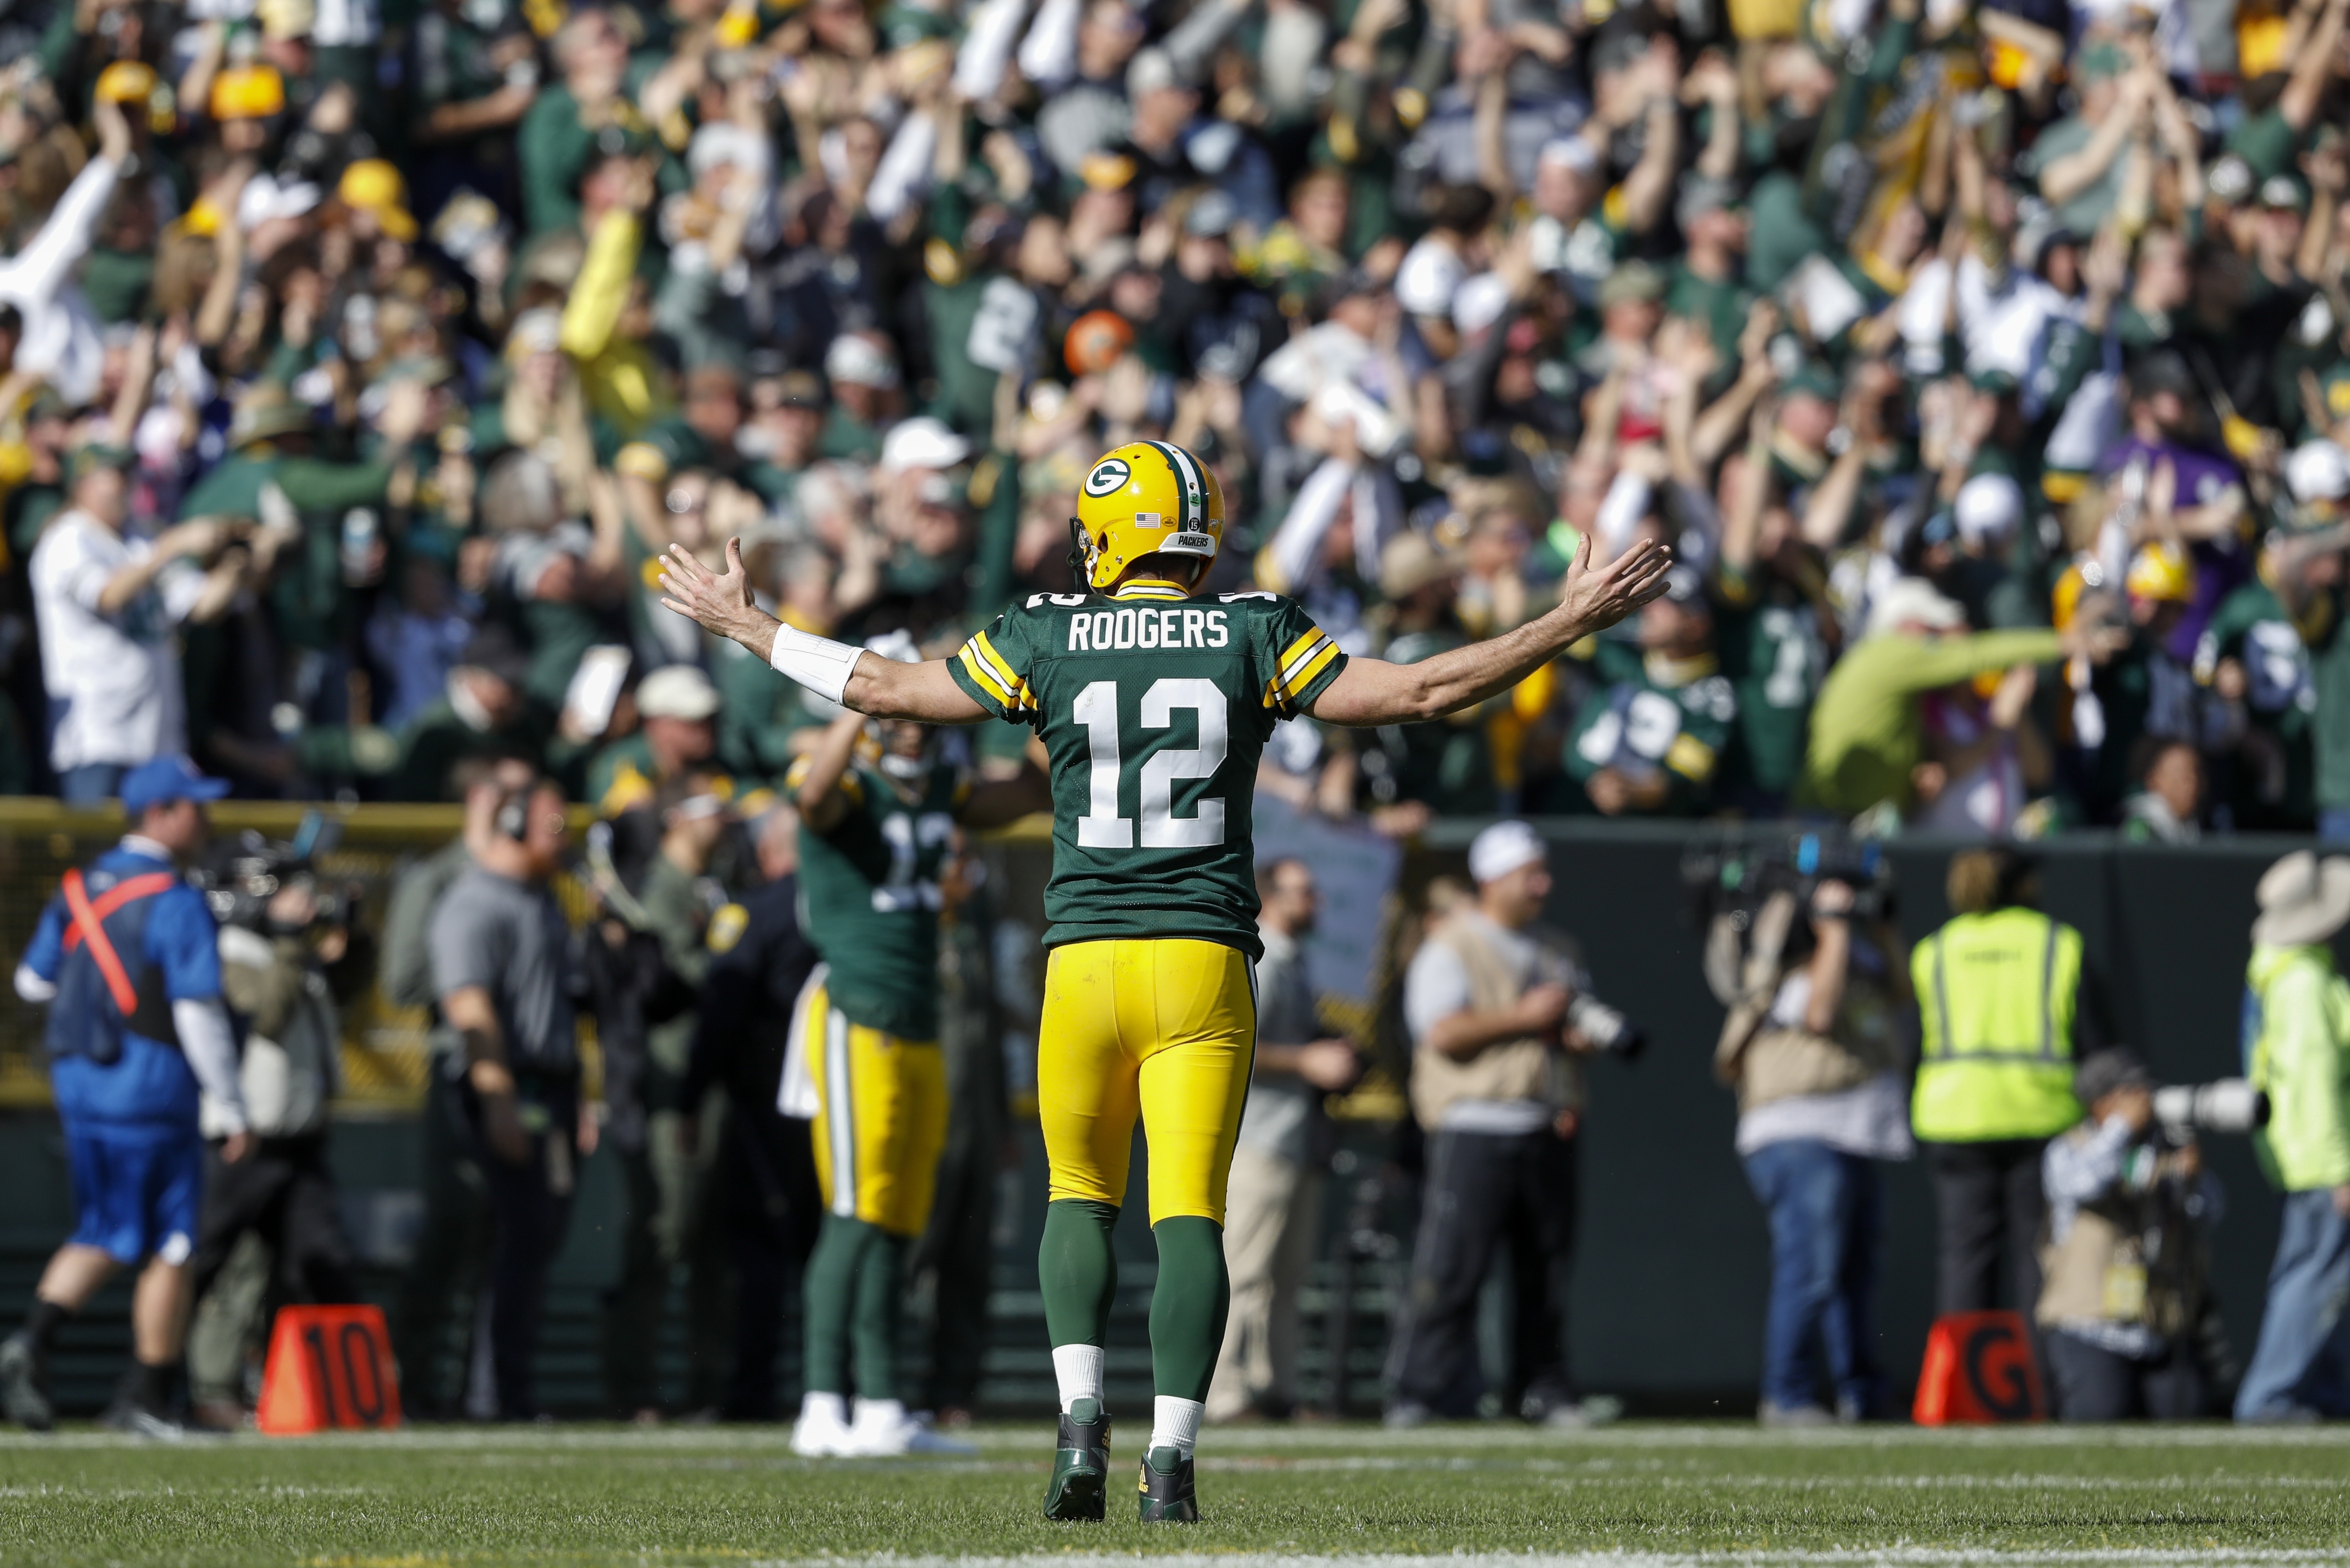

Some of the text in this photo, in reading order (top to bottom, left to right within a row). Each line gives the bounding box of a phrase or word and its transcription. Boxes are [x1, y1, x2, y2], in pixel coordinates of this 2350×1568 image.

[1085, 459, 1129, 497] G
[1177, 535, 1209, 547] PACKERS
[1068, 608, 1228, 651] RODGERS
[1073, 678, 1228, 848] 12
[306, 1322, 384, 1422] 10
[1966, 1327, 2031, 1420] G
